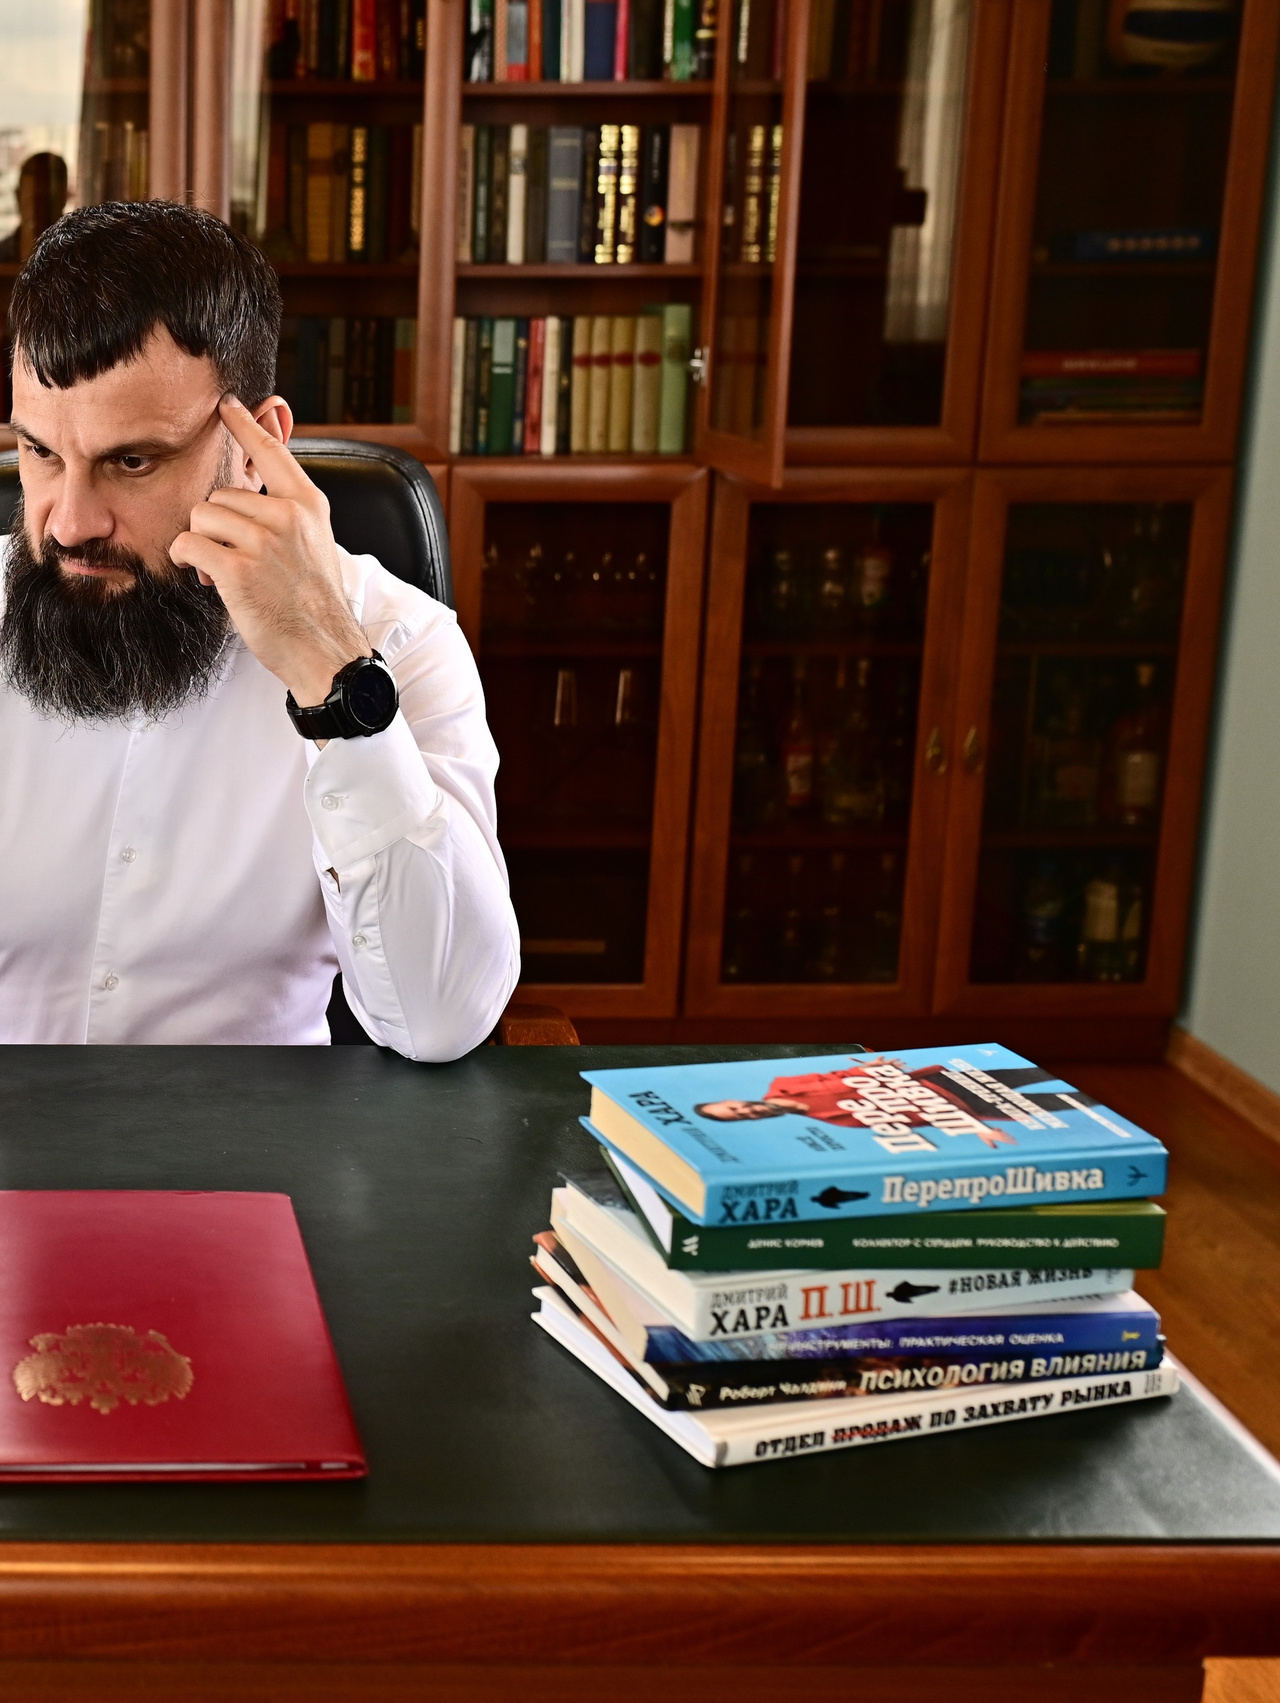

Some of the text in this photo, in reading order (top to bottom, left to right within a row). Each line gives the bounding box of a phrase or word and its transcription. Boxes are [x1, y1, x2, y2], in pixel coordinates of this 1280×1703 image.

[628, 1090, 692, 1126] ХАРА
[836, 1098, 939, 1154] Пере
[722, 1180, 799, 1200] ДМИТРИЙ
[882, 1166, 1104, 1207] ПерепроШивка
[719, 1196, 799, 1224] ХАРА
[710, 1283, 788, 1309] ДМИТРИЙ
[948, 1270, 1022, 1295] #НОВАЯ
[1027, 1268, 1093, 1286] ЖИЗНЬ
[799, 1280, 882, 1321] П. Ш.
[709, 1303, 790, 1336] ХАРА
[898, 1334, 1005, 1348] ПРАКТИЧЕСКАЯ
[1008, 1332, 1065, 1346] ОЦЕНКА
[858, 1350, 1148, 1391] ПСИХОЛОГИЯ ВЛИЯНИЯ
[719, 1380, 847, 1401] Роберт Чалдини
[754, 1431, 826, 1457] ОТДЕЛ
[830, 1414, 922, 1444] ПРОДАЖ
[928, 1409, 957, 1428] ПО
[962, 1392, 1054, 1423] ЗАХВАТУ
[1060, 1380, 1132, 1407] РЫНКА
